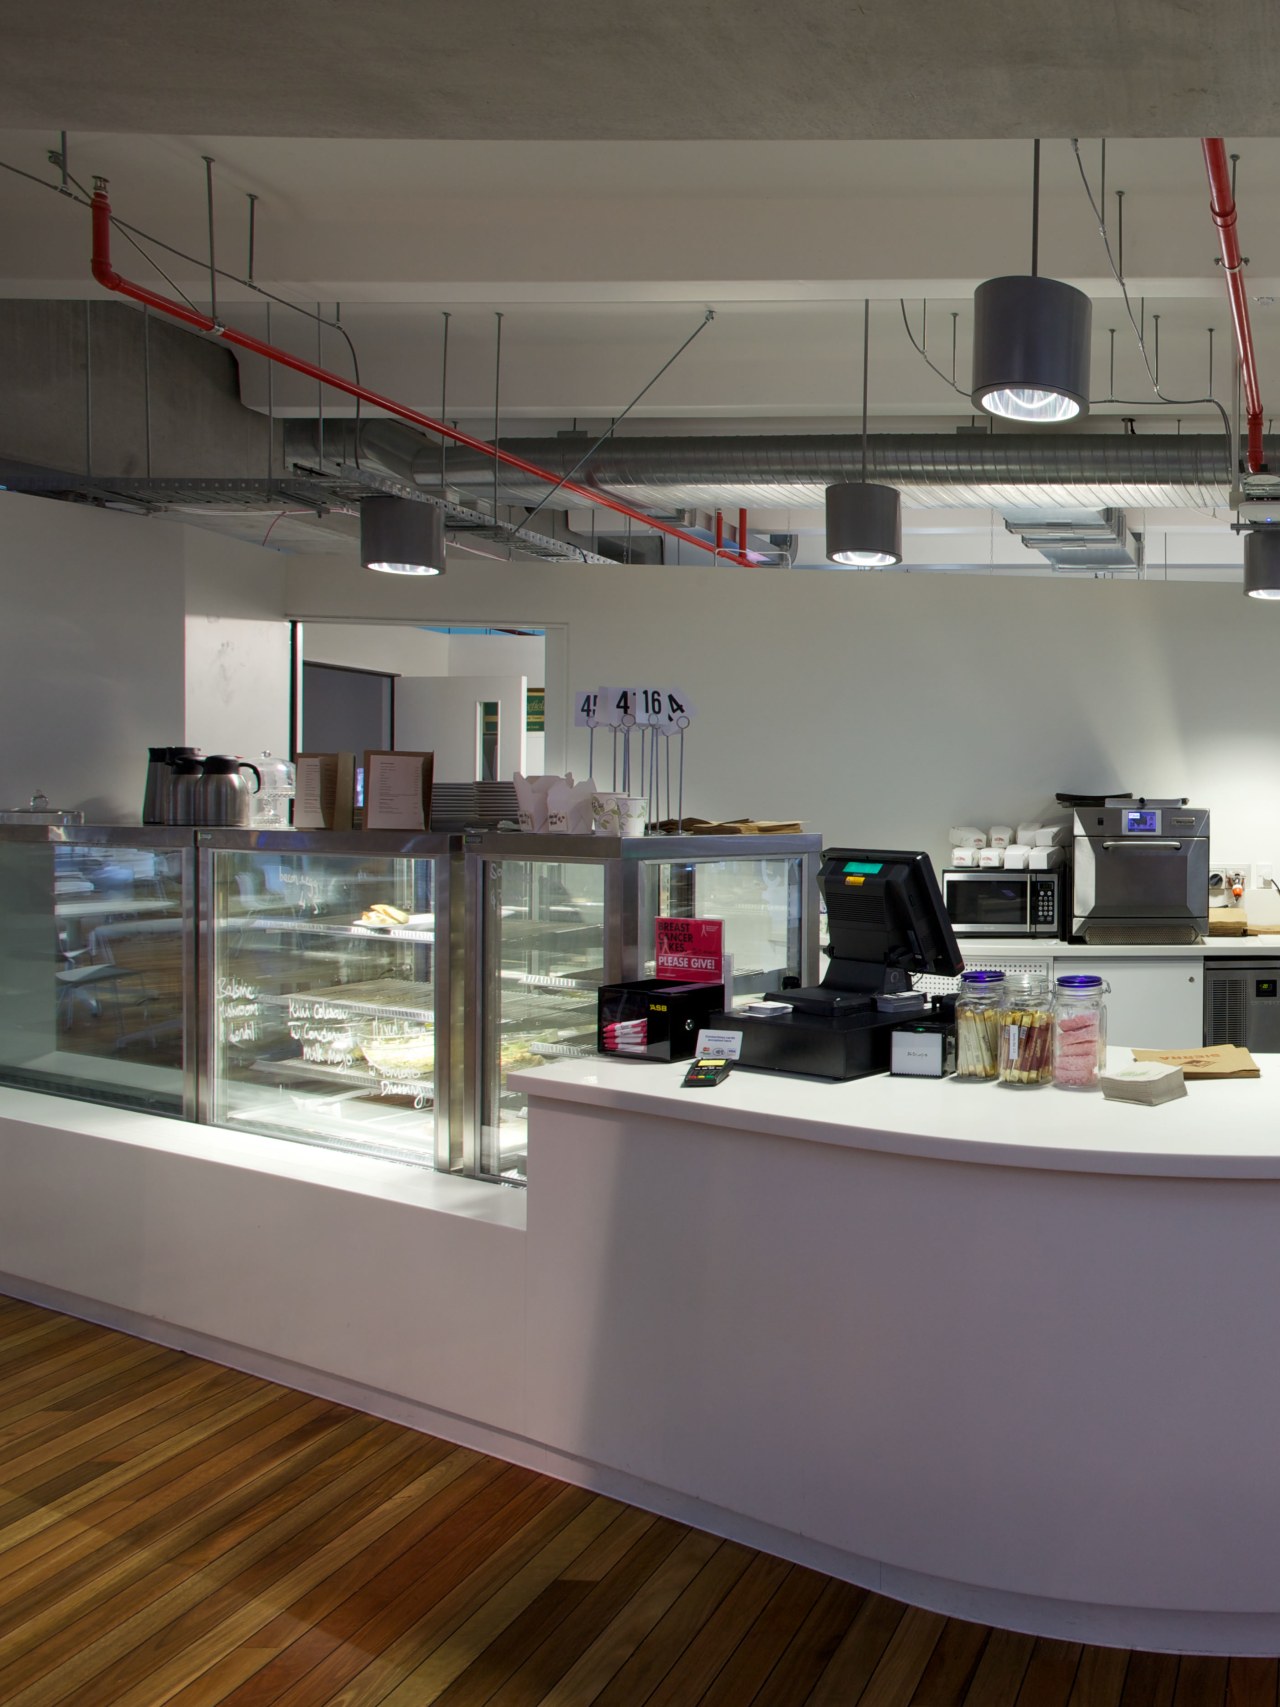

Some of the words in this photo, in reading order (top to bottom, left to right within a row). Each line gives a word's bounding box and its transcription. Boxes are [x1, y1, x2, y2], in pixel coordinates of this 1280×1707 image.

[616, 691, 636, 714] 4
[643, 690, 661, 714] 16
[658, 922, 690, 932] BREAST
[658, 932, 693, 943] CANCER
[658, 956, 688, 967] PLEASE
[691, 958, 715, 969] GIVE!
[650, 1004, 668, 1012] ASB
